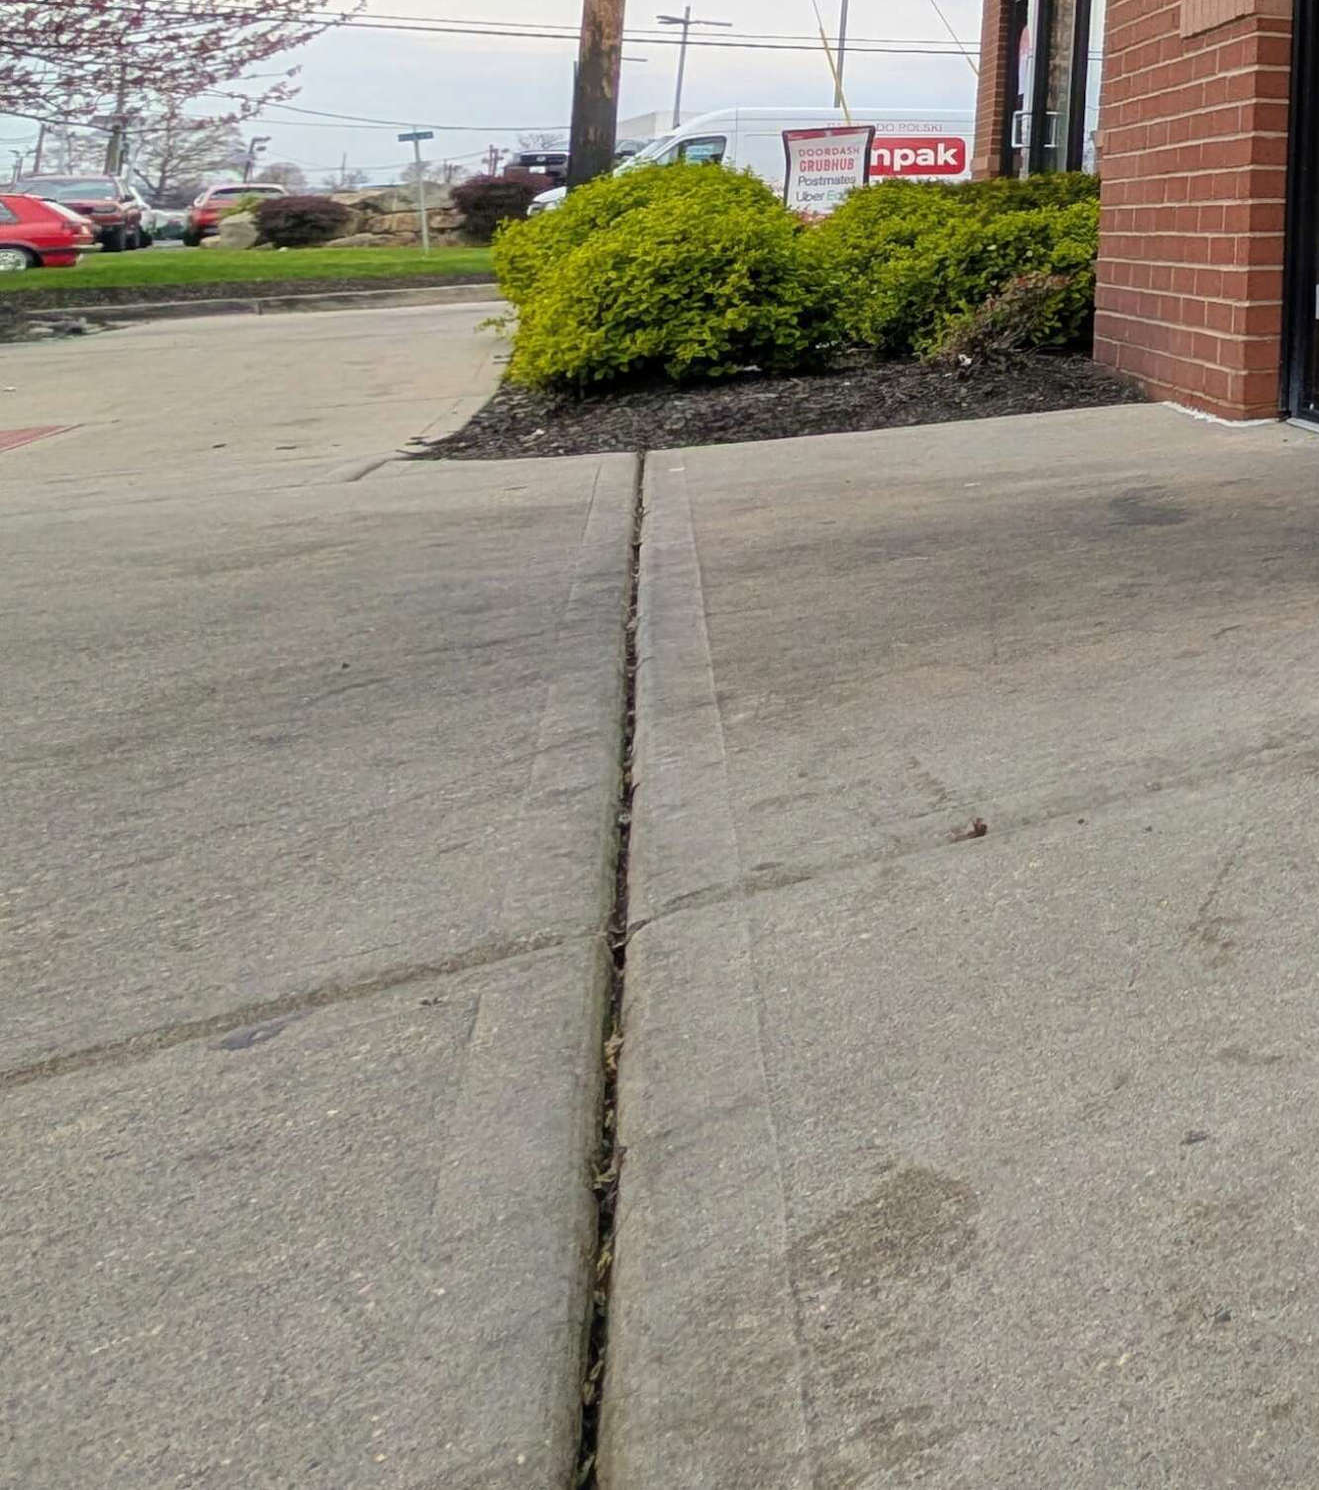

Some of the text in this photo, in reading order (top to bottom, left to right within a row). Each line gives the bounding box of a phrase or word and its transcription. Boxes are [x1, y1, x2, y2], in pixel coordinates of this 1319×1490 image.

[798, 146, 860, 157] DOORDASH
[799, 158, 855, 172] GRUBHUB
[798, 174, 856, 187] Postmates
[796, 190, 847, 202] Uber Ea
